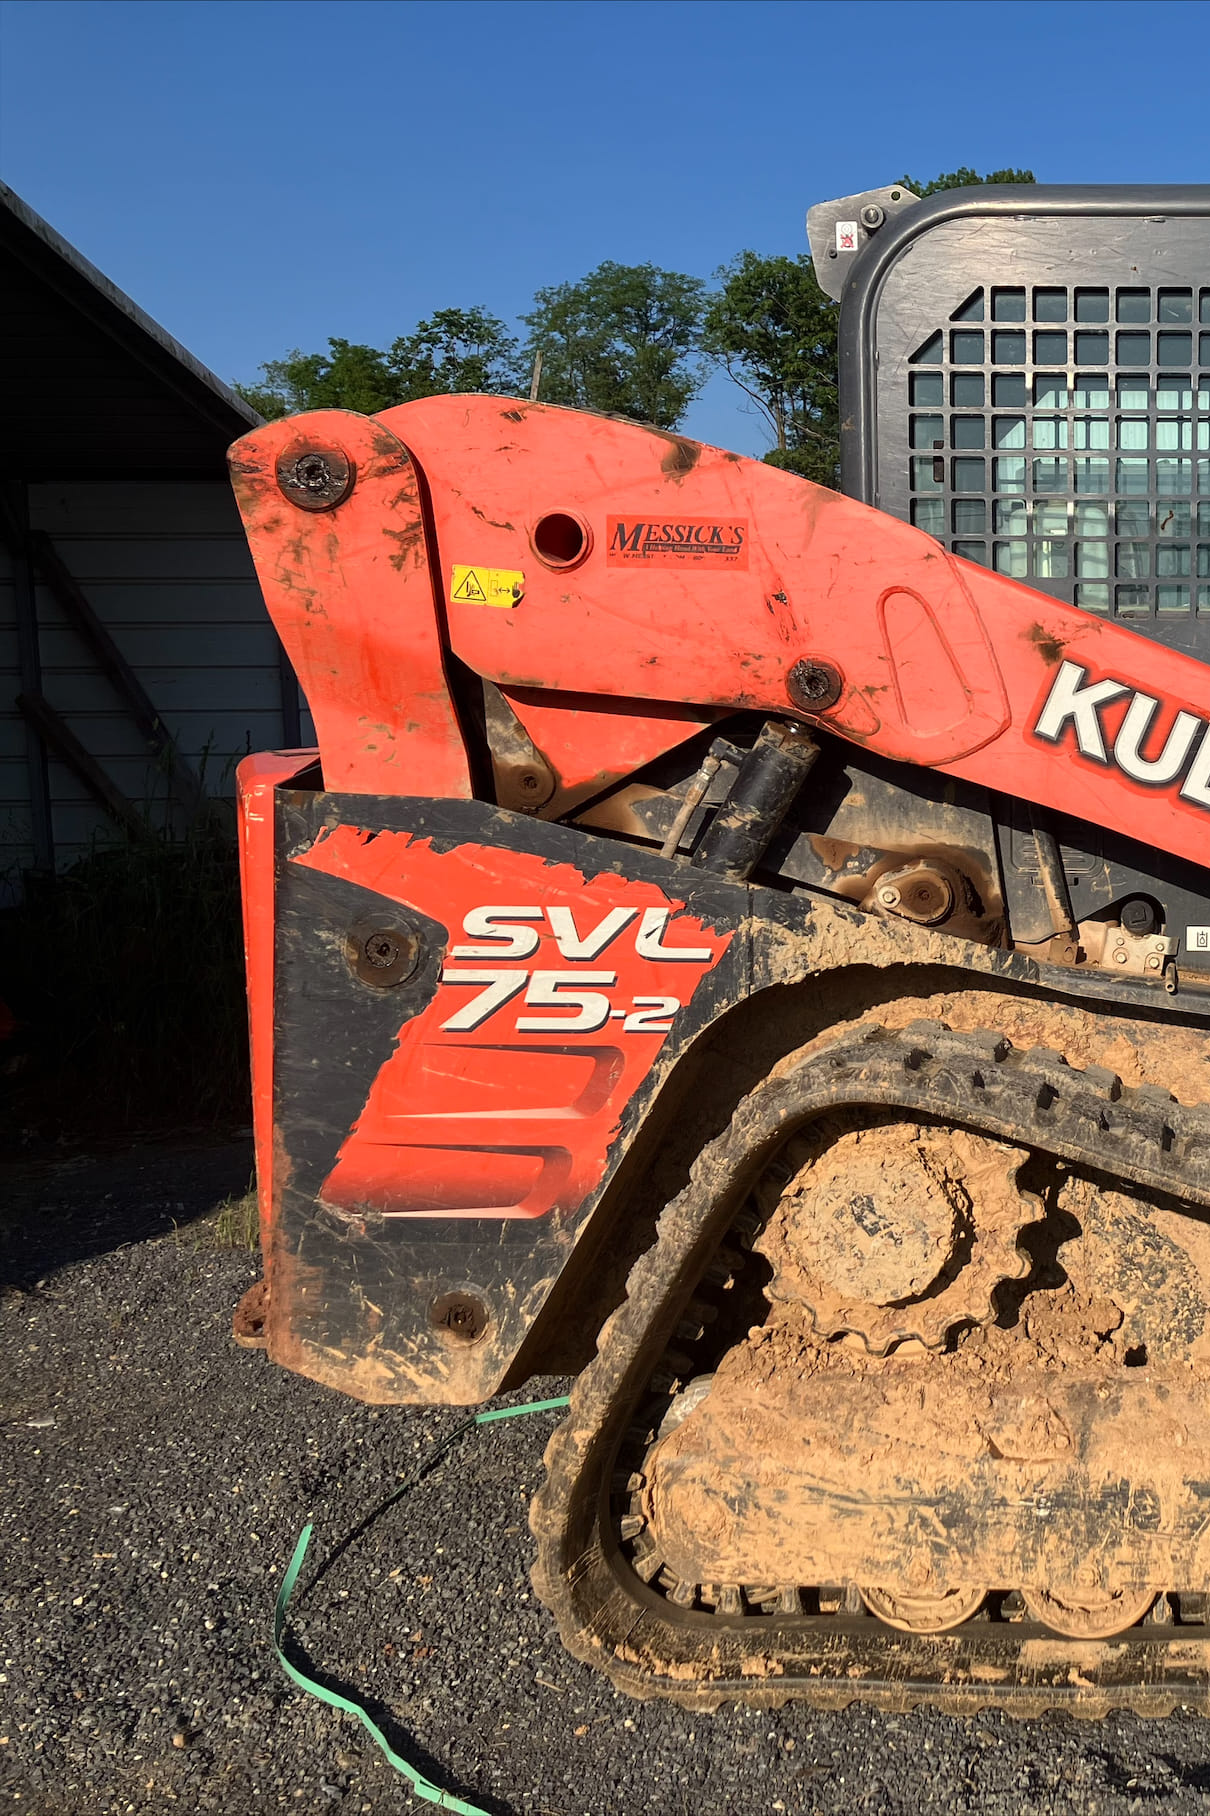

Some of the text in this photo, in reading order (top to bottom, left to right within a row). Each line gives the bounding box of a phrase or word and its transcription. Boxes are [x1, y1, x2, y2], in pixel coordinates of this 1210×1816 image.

[610, 523, 745, 551] MESSICK'S
[449, 905, 715, 963] SVL
[438, 968, 681, 1034] 75-2
